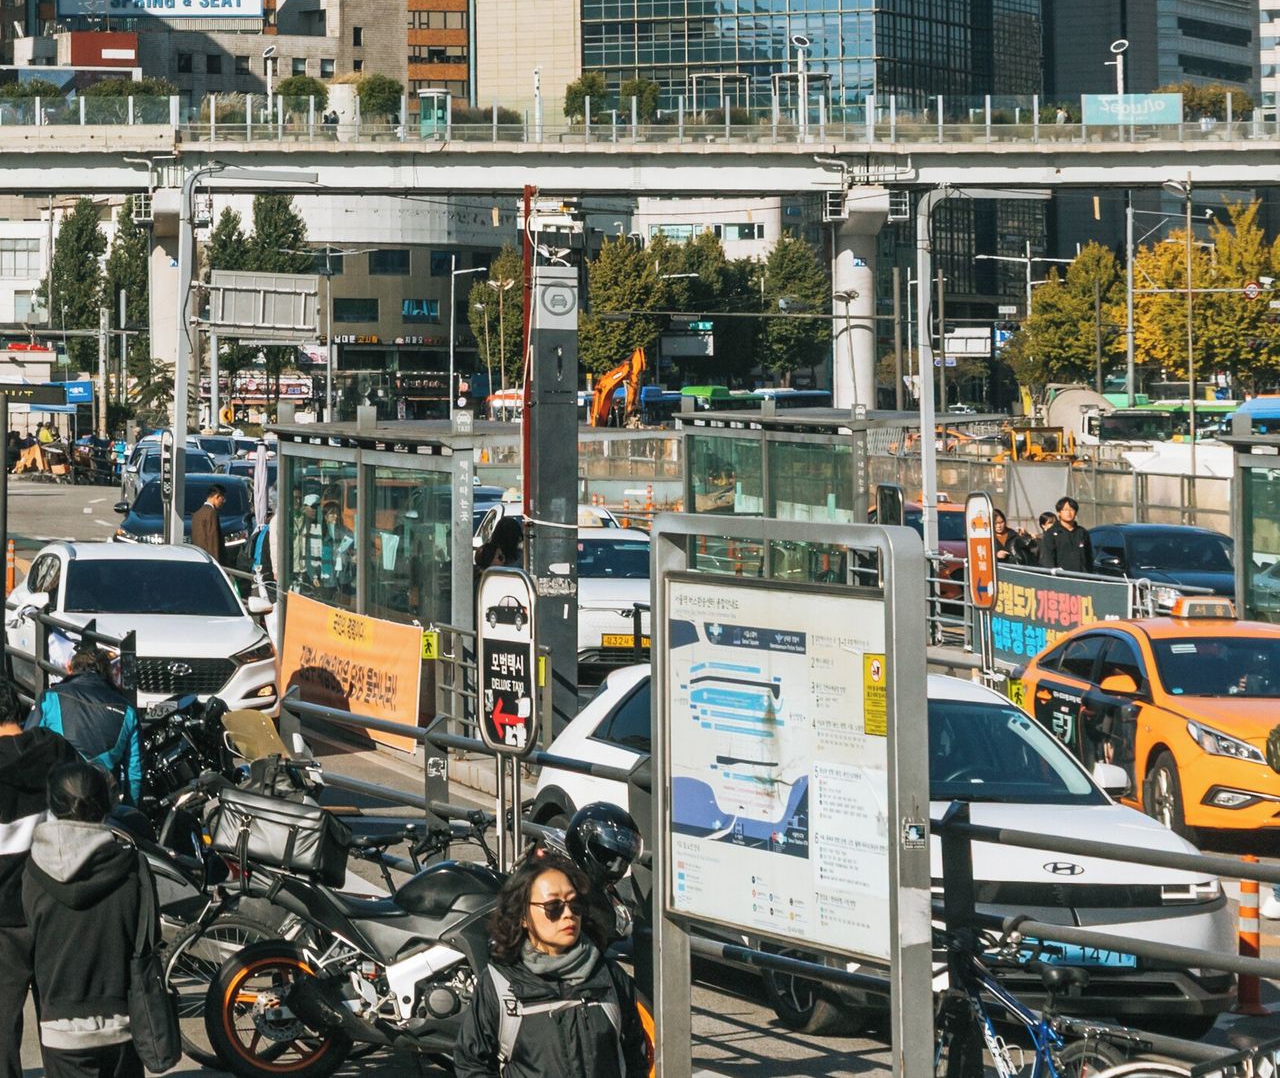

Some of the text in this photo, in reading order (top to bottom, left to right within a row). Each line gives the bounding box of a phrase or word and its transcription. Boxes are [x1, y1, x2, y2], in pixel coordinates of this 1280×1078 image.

[1194, 604, 1225, 618] 서울
[491, 653, 524, 677] 모범택시
[491, 677, 512, 692] DELUXE
